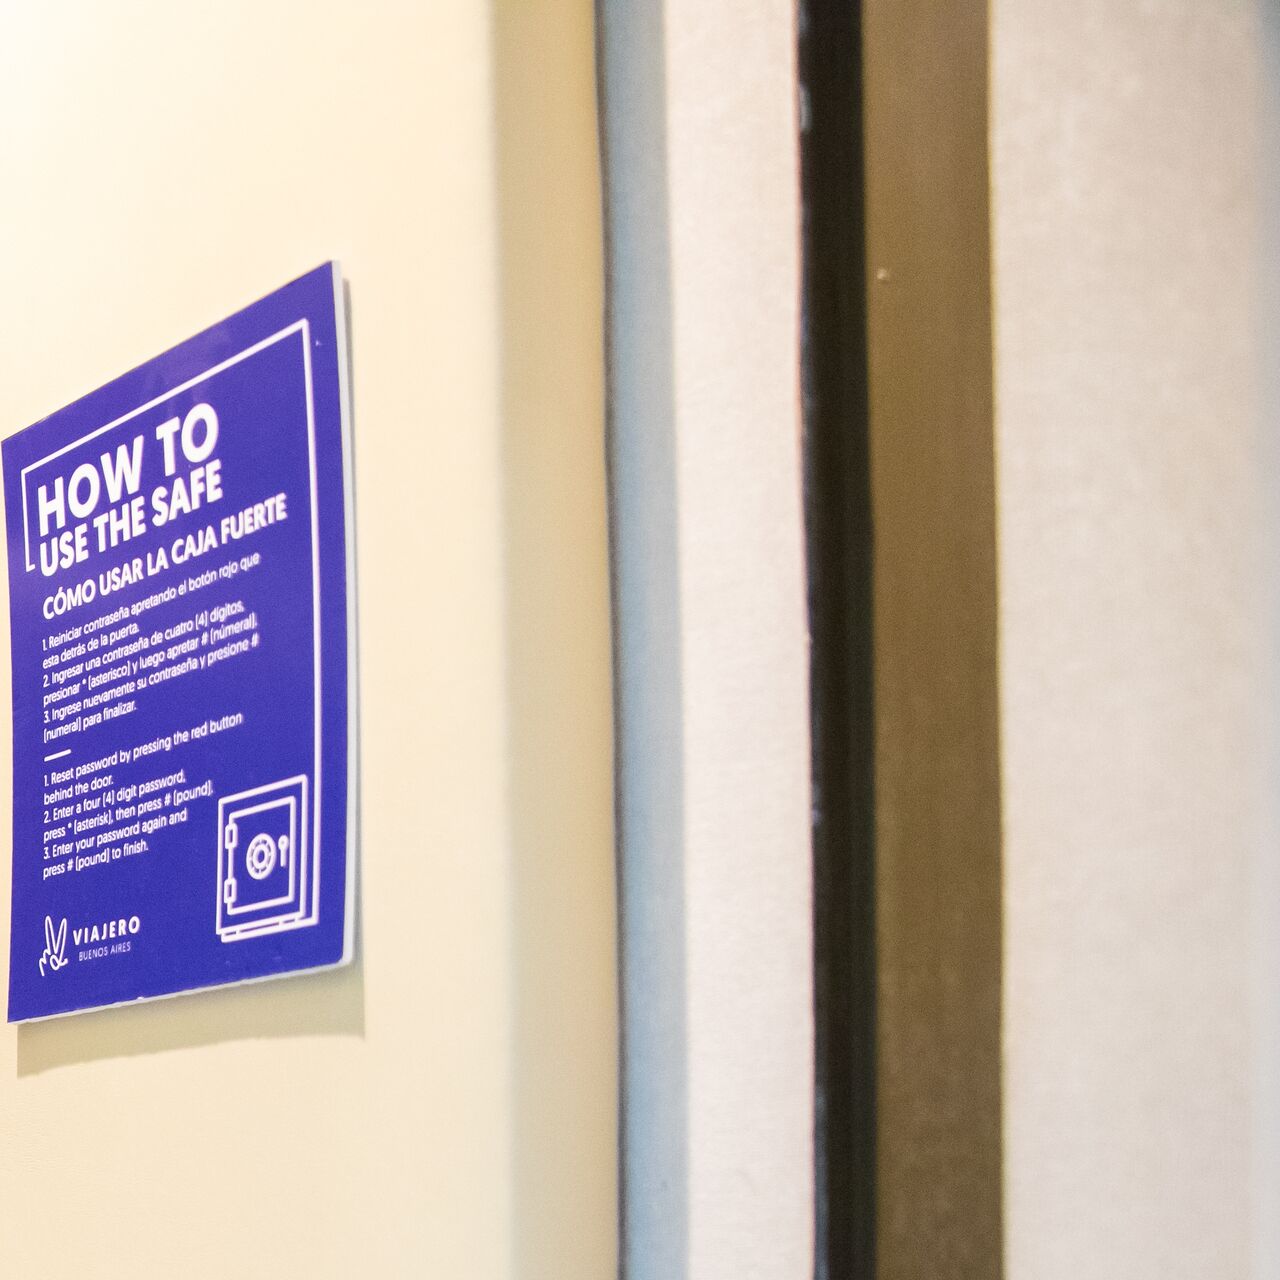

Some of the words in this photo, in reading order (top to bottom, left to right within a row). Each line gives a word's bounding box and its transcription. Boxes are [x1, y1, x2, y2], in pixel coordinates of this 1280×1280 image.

[37, 435, 144, 537] HOW
[156, 403, 219, 477] TO
[40, 521, 89, 577] USE
[93, 496, 146, 553] THE
[151, 459, 223, 527] SAFE
[42, 578, 96, 620] CÓMO
[99, 558, 144, 596] USAR
[146, 547, 169, 577] LA
[171, 525, 218, 564] CAJA
[221, 492, 288, 545] FUERTE
[48, 626, 82, 648] Reiniciar
[83, 606, 130, 634] contraseña
[130, 586, 177, 615] apretando
[177, 579, 187, 595] el
[188, 570, 218, 591] botón
[218, 561, 239, 578] rojo
[239, 552, 260, 571] que
[43, 682, 80, 707] presionar
[131, 660, 138, 674] y
[139, 650, 165, 669] luego
[166, 637, 199, 660] apretar
[200, 631, 209, 646] #
[51, 662, 84, 683] Ingresar
[84, 656, 101, 671] una
[101, 636, 149, 664] contraseña
[150, 630, 163, 645] de
[164, 619, 194, 640] cuatro
[60, 642, 86, 662] detrás
[86, 637, 99, 651] de
[100, 633, 108, 646] la
[51, 701, 82, 720] Ingrese
[82, 681, 135, 709] nuevamente
[136, 676, 147, 689] su
[148, 657, 198, 685] contraseña
[199, 654, 206, 669] y
[207, 638, 249, 666] presione
[250, 632, 259, 647] #
[82, 712, 102, 730] para
[50, 767, 74, 784] Reset
[75, 751, 117, 779] password
[119, 749, 131, 763] by
[132, 736, 171, 760] pressing
[173, 730, 189, 745] the
[190, 721, 208, 739] red
[209, 713, 243, 733] button
[43, 784, 73, 805] behind
[74, 782, 89, 795] the
[43, 826, 66, 844] press
[115, 805, 136, 820] then
[137, 798, 162, 817] press
[163, 792, 171, 806] #
[52, 805, 74, 820] Enter
[75, 803, 81, 814] a
[83, 797, 101, 811] four
[116, 784, 137, 802] digit
[52, 842, 73, 857] Enter
[75, 836, 95, 853] your
[96, 821, 140, 847] password
[141, 815, 167, 834] again
[168, 807, 187, 825] and
[43, 863, 65, 880] press
[66, 858, 73, 871] #
[111, 847, 121, 859] to
[73, 915, 141, 946] VIAJERO
[78, 946, 109, 962] BUENOS
[110, 941, 131, 955] AIRES
